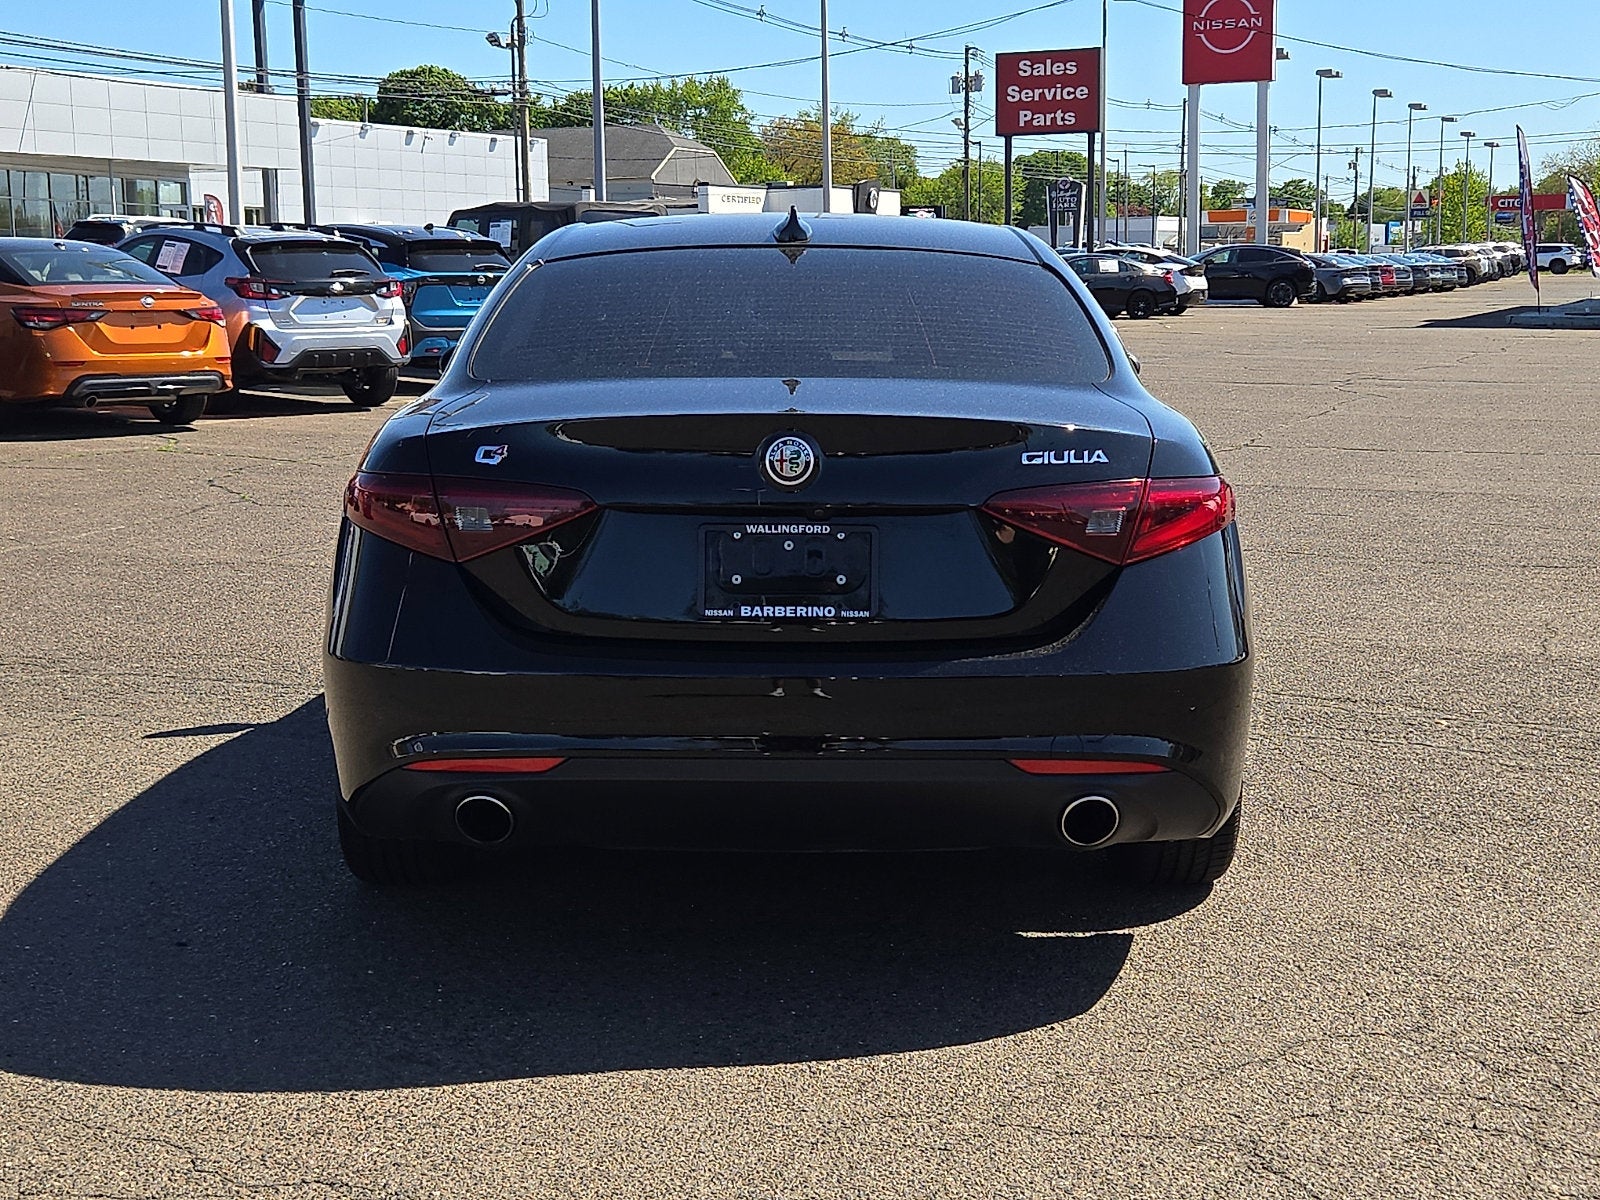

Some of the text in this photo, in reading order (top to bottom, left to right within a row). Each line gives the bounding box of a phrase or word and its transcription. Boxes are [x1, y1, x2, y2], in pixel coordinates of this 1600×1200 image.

[1193, 17, 1262, 31] NISSAN
[1018, 59, 1077, 77] Sales
[1006, 84, 1089, 102] Service
[1019, 109, 1076, 127] Parts
[721, 194, 762, 204] CERTIFIED
[1498, 198, 1521, 208] CITG
[1022, 449, 1109, 465] GIULIA
[746, 524, 831, 534] WALLINGFORD
[705, 606, 870, 618] NISSAN BARBERINO NISSAN
